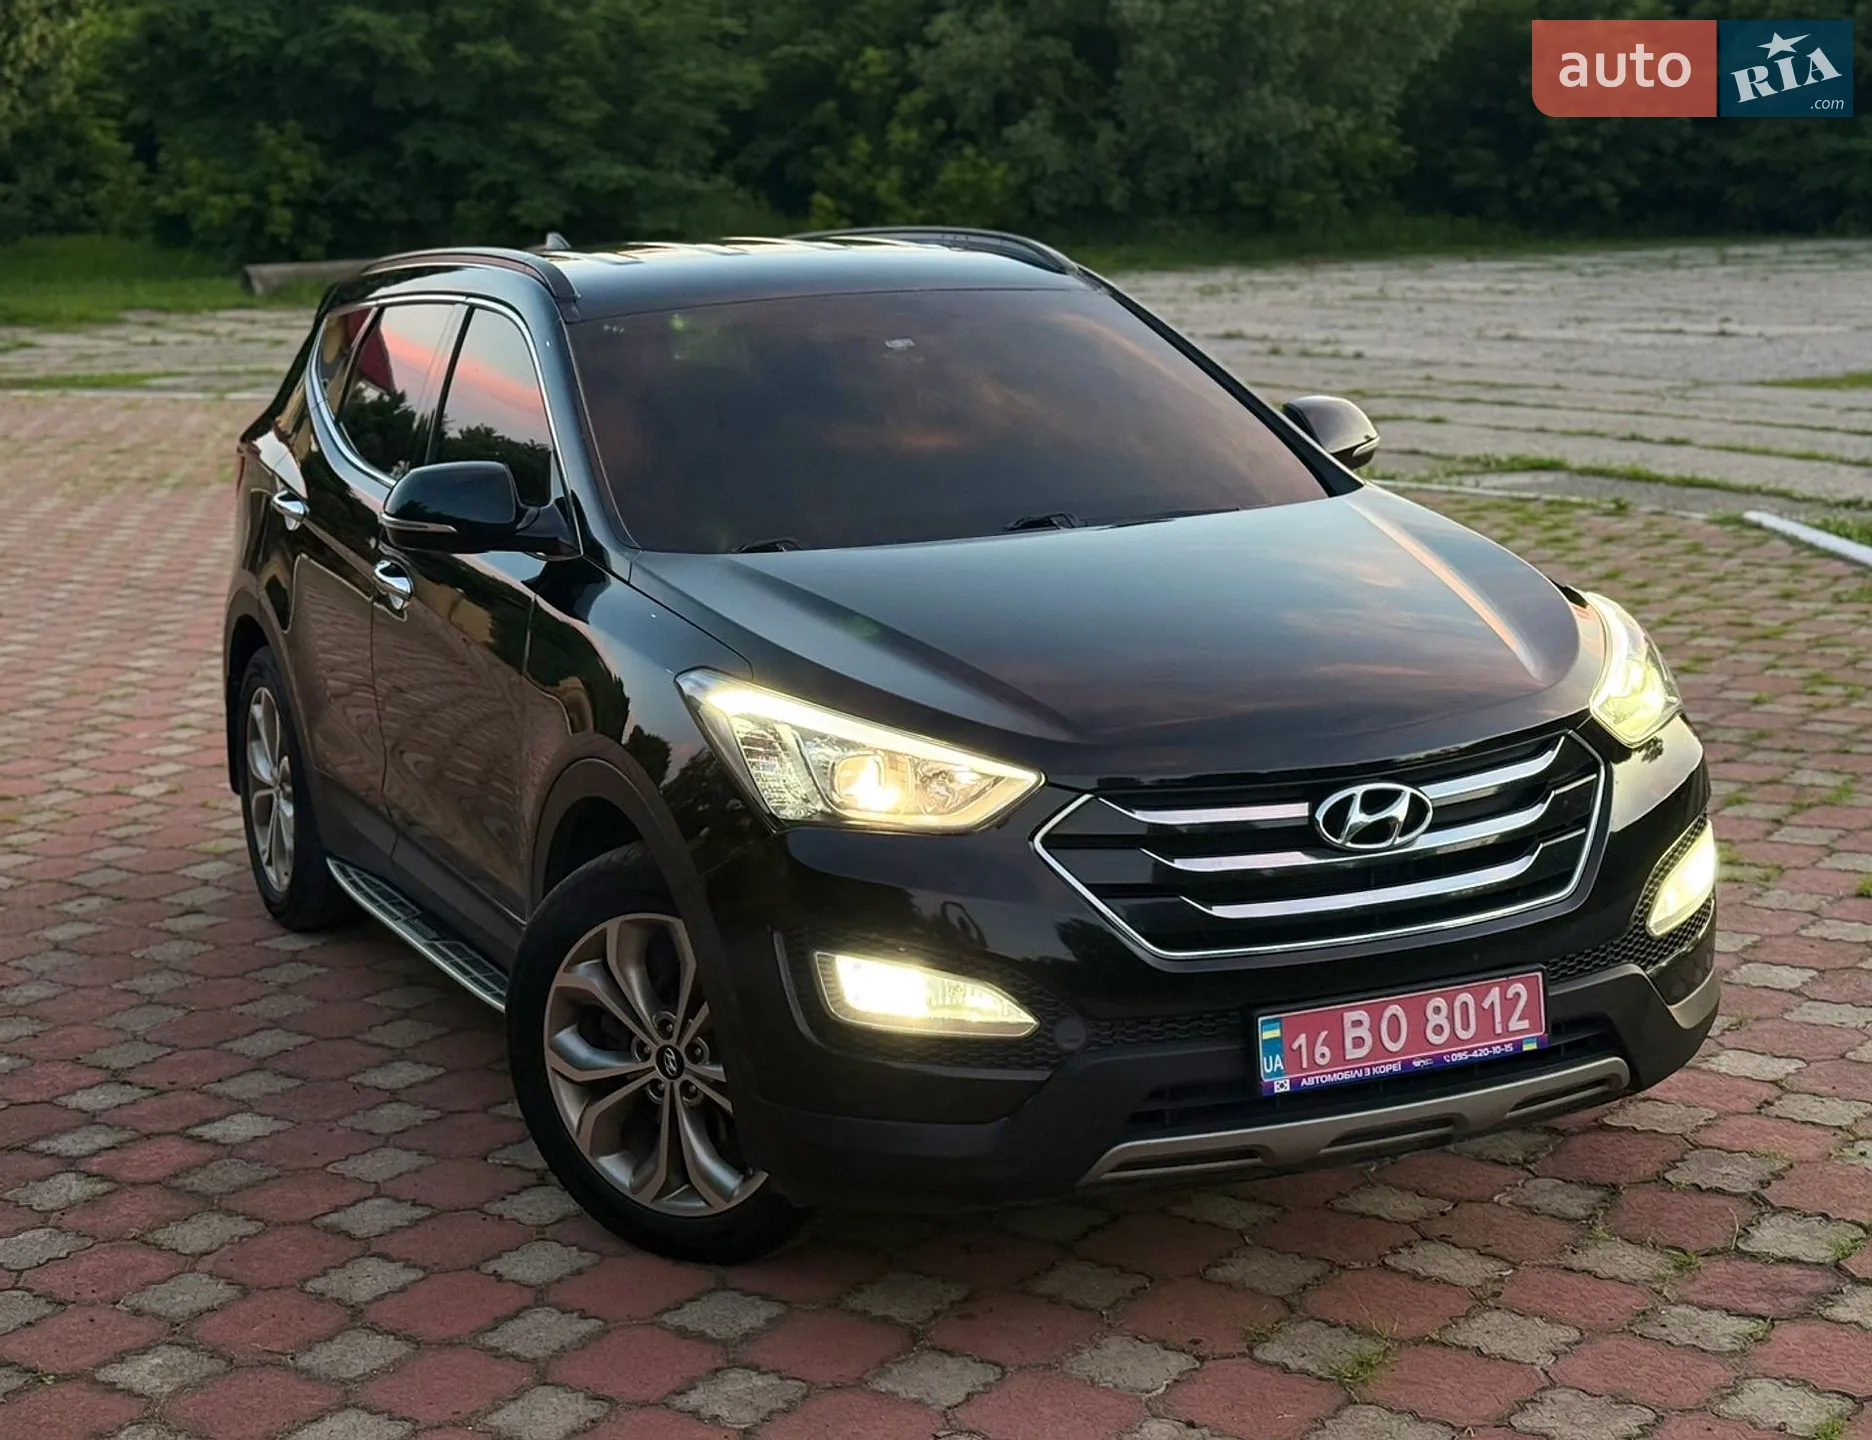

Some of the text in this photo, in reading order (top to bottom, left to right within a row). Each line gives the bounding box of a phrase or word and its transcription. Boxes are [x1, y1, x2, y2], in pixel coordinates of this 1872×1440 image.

[1291, 982, 1531, 1069] 16 BO 8012
[1263, 1054, 1285, 1073] UA
[1300, 1068, 1363, 1087] АВТОМОБІЛІ
[1372, 1061, 1402, 1076] КОРЕЇ
